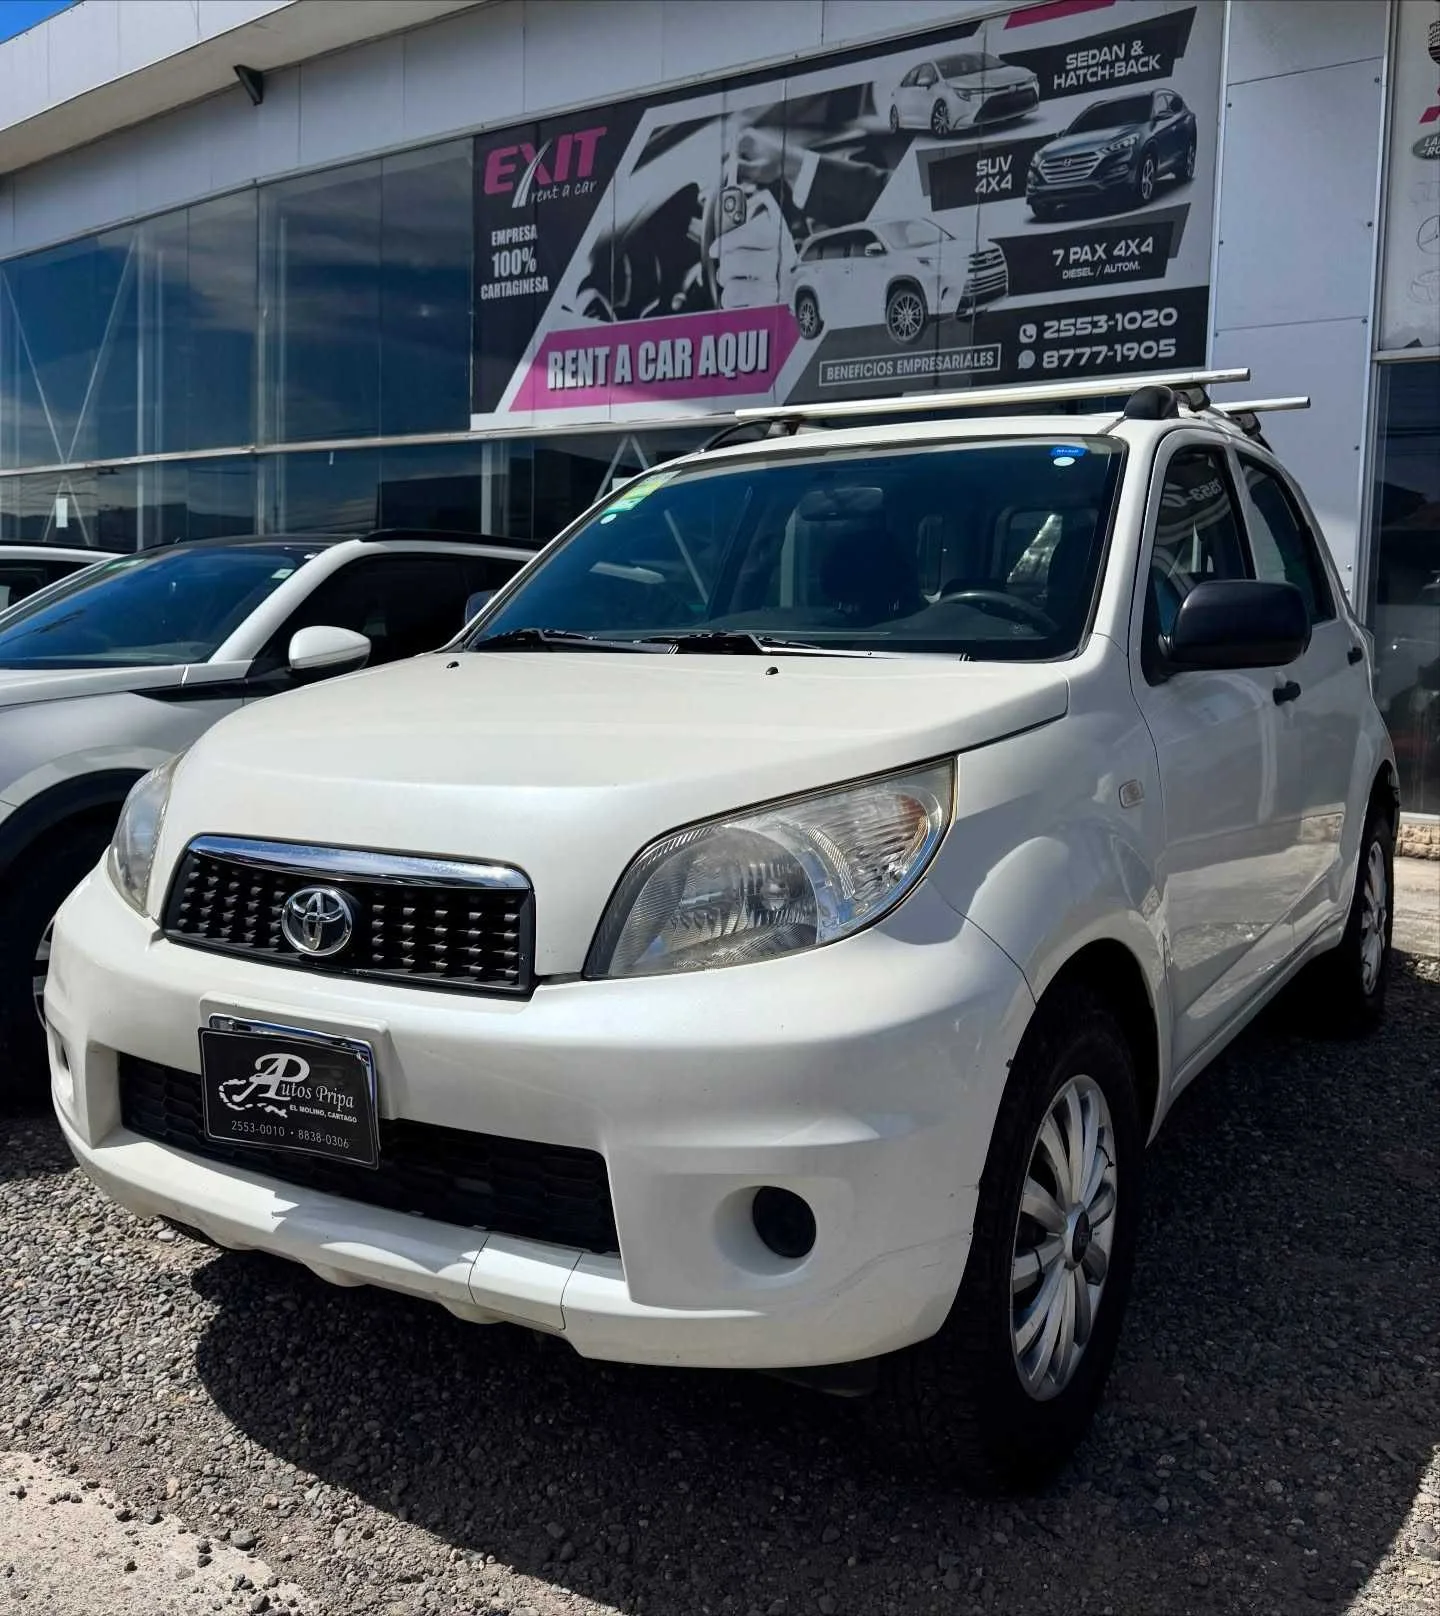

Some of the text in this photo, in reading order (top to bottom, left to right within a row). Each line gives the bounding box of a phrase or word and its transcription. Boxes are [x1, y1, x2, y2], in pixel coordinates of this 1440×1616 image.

[1065, 40, 1145, 70] SEDAN &
[1053, 54, 1161, 90] HATCH-BACK
[484, 126, 607, 207] EXIT
[976, 154, 1013, 176] SUV
[531, 180, 598, 203] rent a car
[975, 173, 1013, 194] 4X4
[491, 224, 538, 247] EMPRESA
[491, 246, 538, 278] 100%
[1052, 236, 1154, 266] 7 PAX 4X4
[1062, 267, 1095, 279] DIESEL
[1104, 261, 1141, 275] AUTOM.
[480, 275, 549, 300] CARTAGINESA
[1043, 307, 1178, 339] 2553-1020
[547, 329, 770, 391] RENT A CAR AQUI
[826, 350, 994, 381] BENEFICIOS EMPRESARIALES
[1042, 338, 1176, 369] 8777-1905
[316, 1085, 355, 1112] Pripa
[289, 1104, 298, 1112] EL
[327, 1111, 358, 1123] CARTAGO
[231, 1119, 285, 1137] 2553-0010
